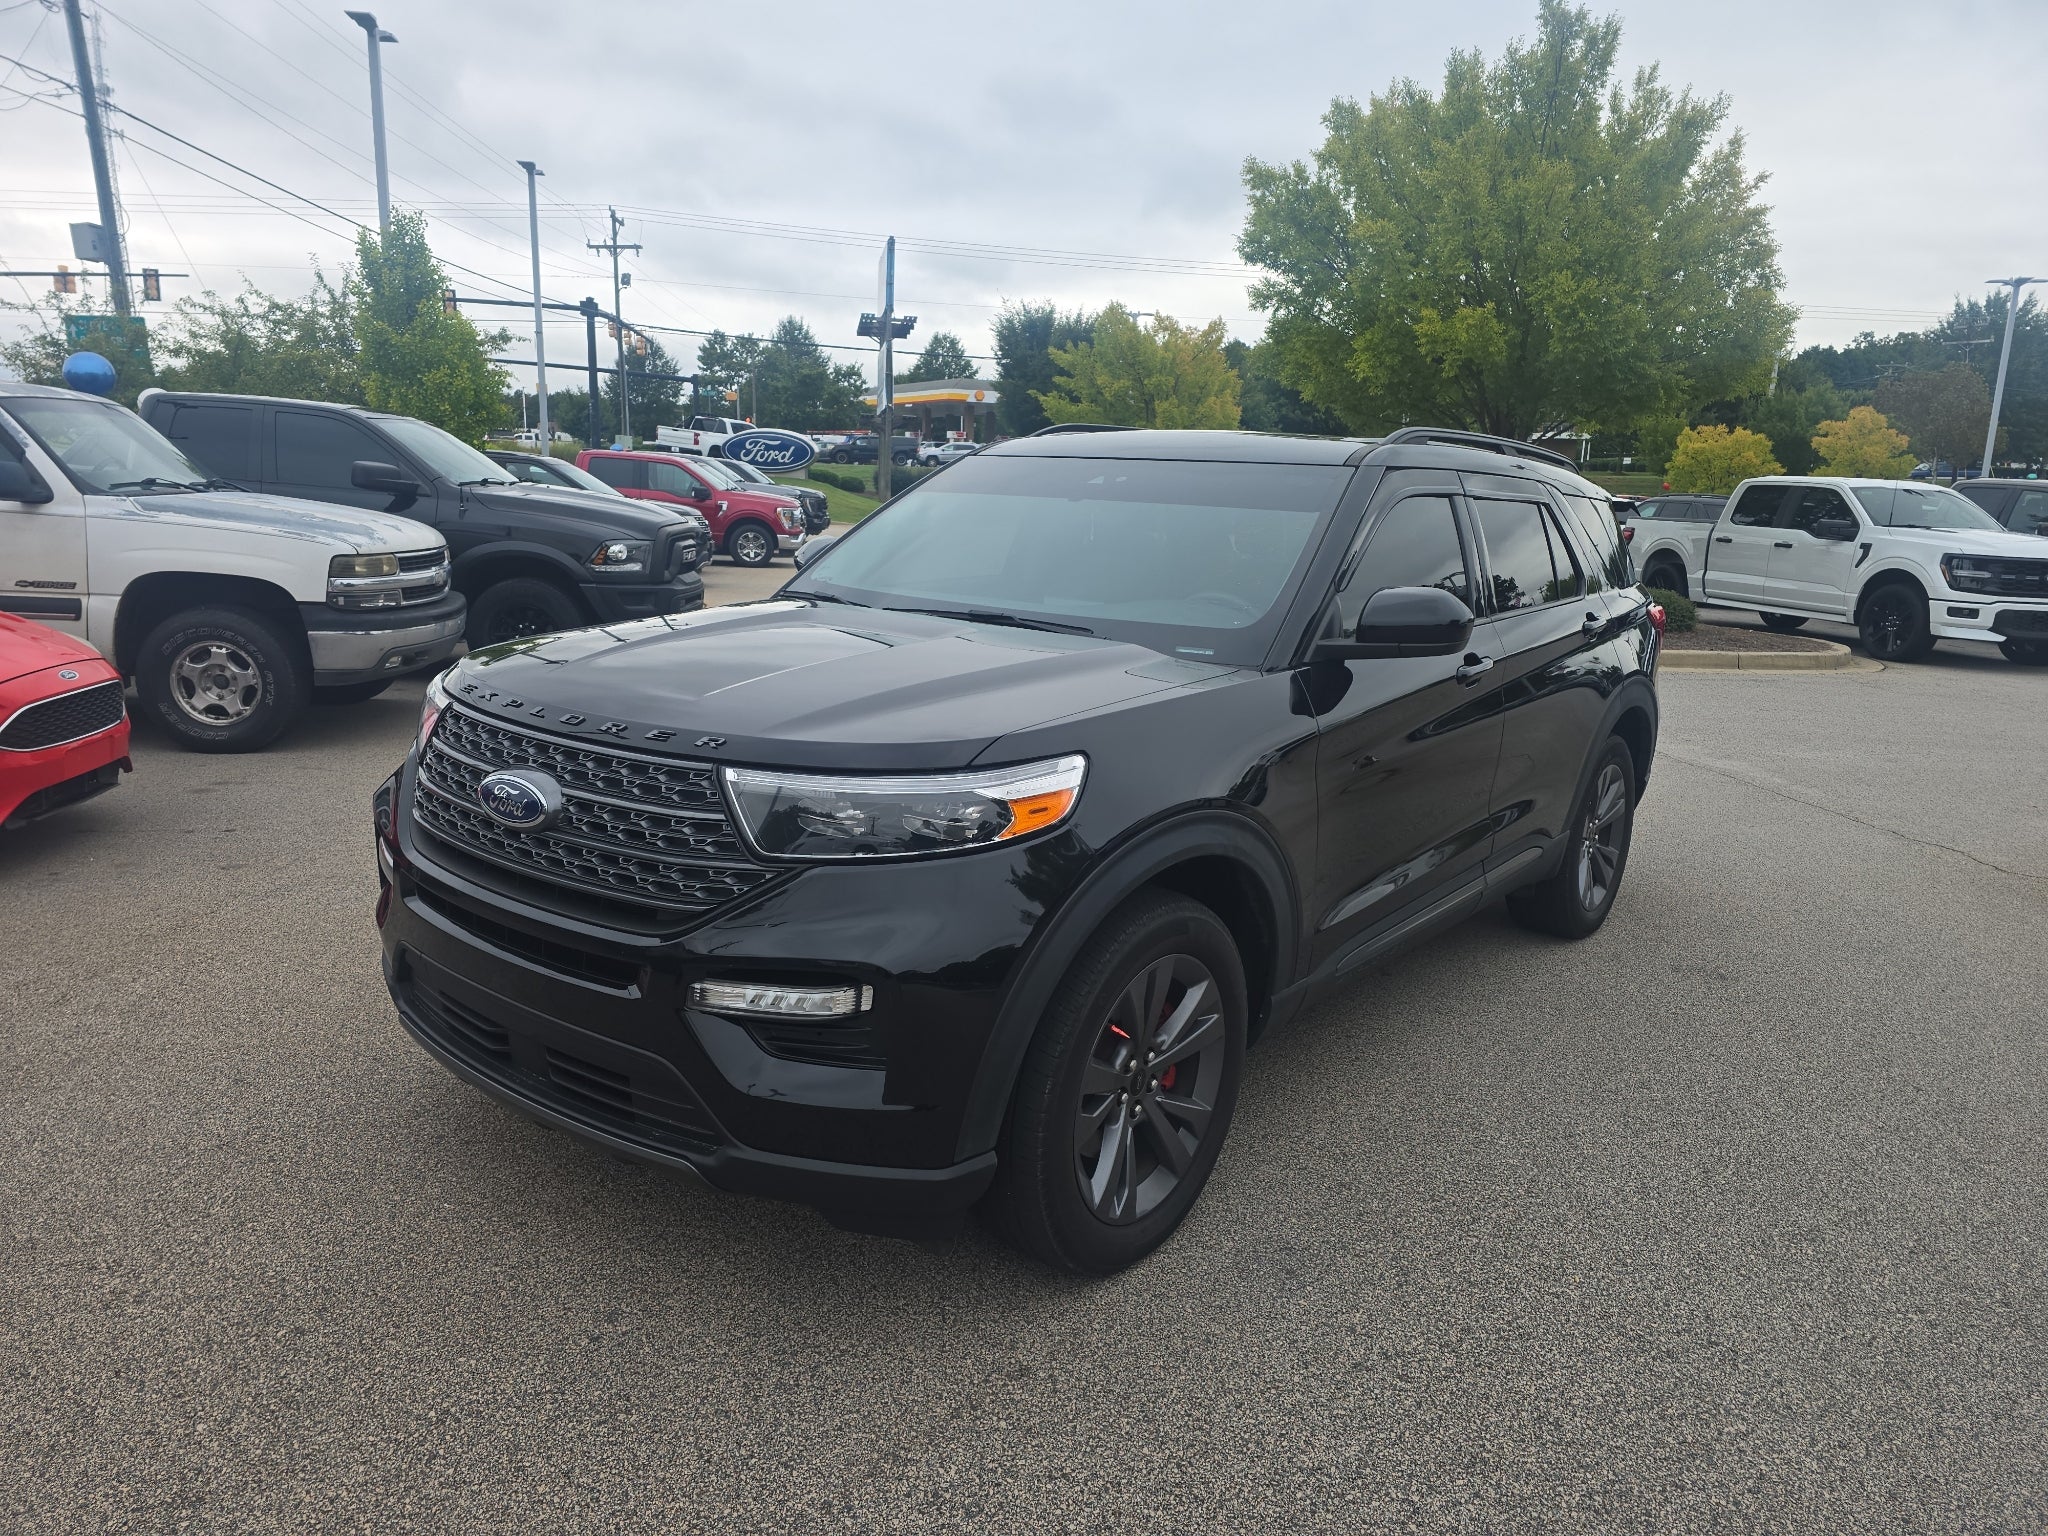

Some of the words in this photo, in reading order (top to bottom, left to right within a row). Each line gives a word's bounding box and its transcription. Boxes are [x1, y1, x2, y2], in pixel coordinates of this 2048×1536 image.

[740, 439, 795, 463] Ford
[32, 580, 77, 589] TAHOE
[157, 702, 230, 740] COOPER
[459, 683, 728, 750] EXPLORER
[490, 784, 528, 817] Ford
